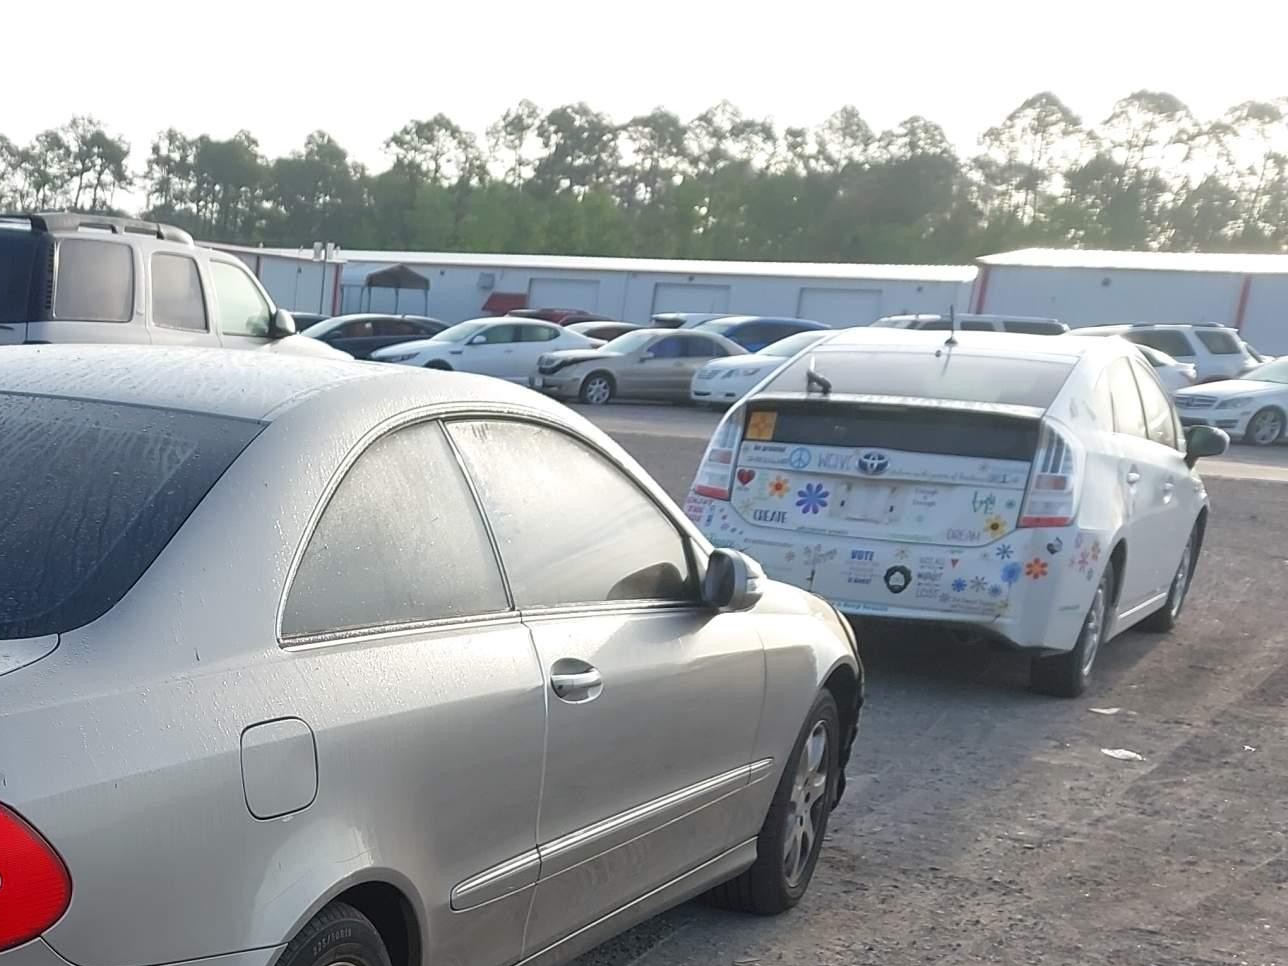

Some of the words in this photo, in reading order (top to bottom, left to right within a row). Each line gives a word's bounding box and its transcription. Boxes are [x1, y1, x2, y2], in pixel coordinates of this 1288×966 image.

[753, 508, 787, 524] CREATE
[946, 528, 981, 543] DREAM
[851, 549, 875, 561] VOTE
